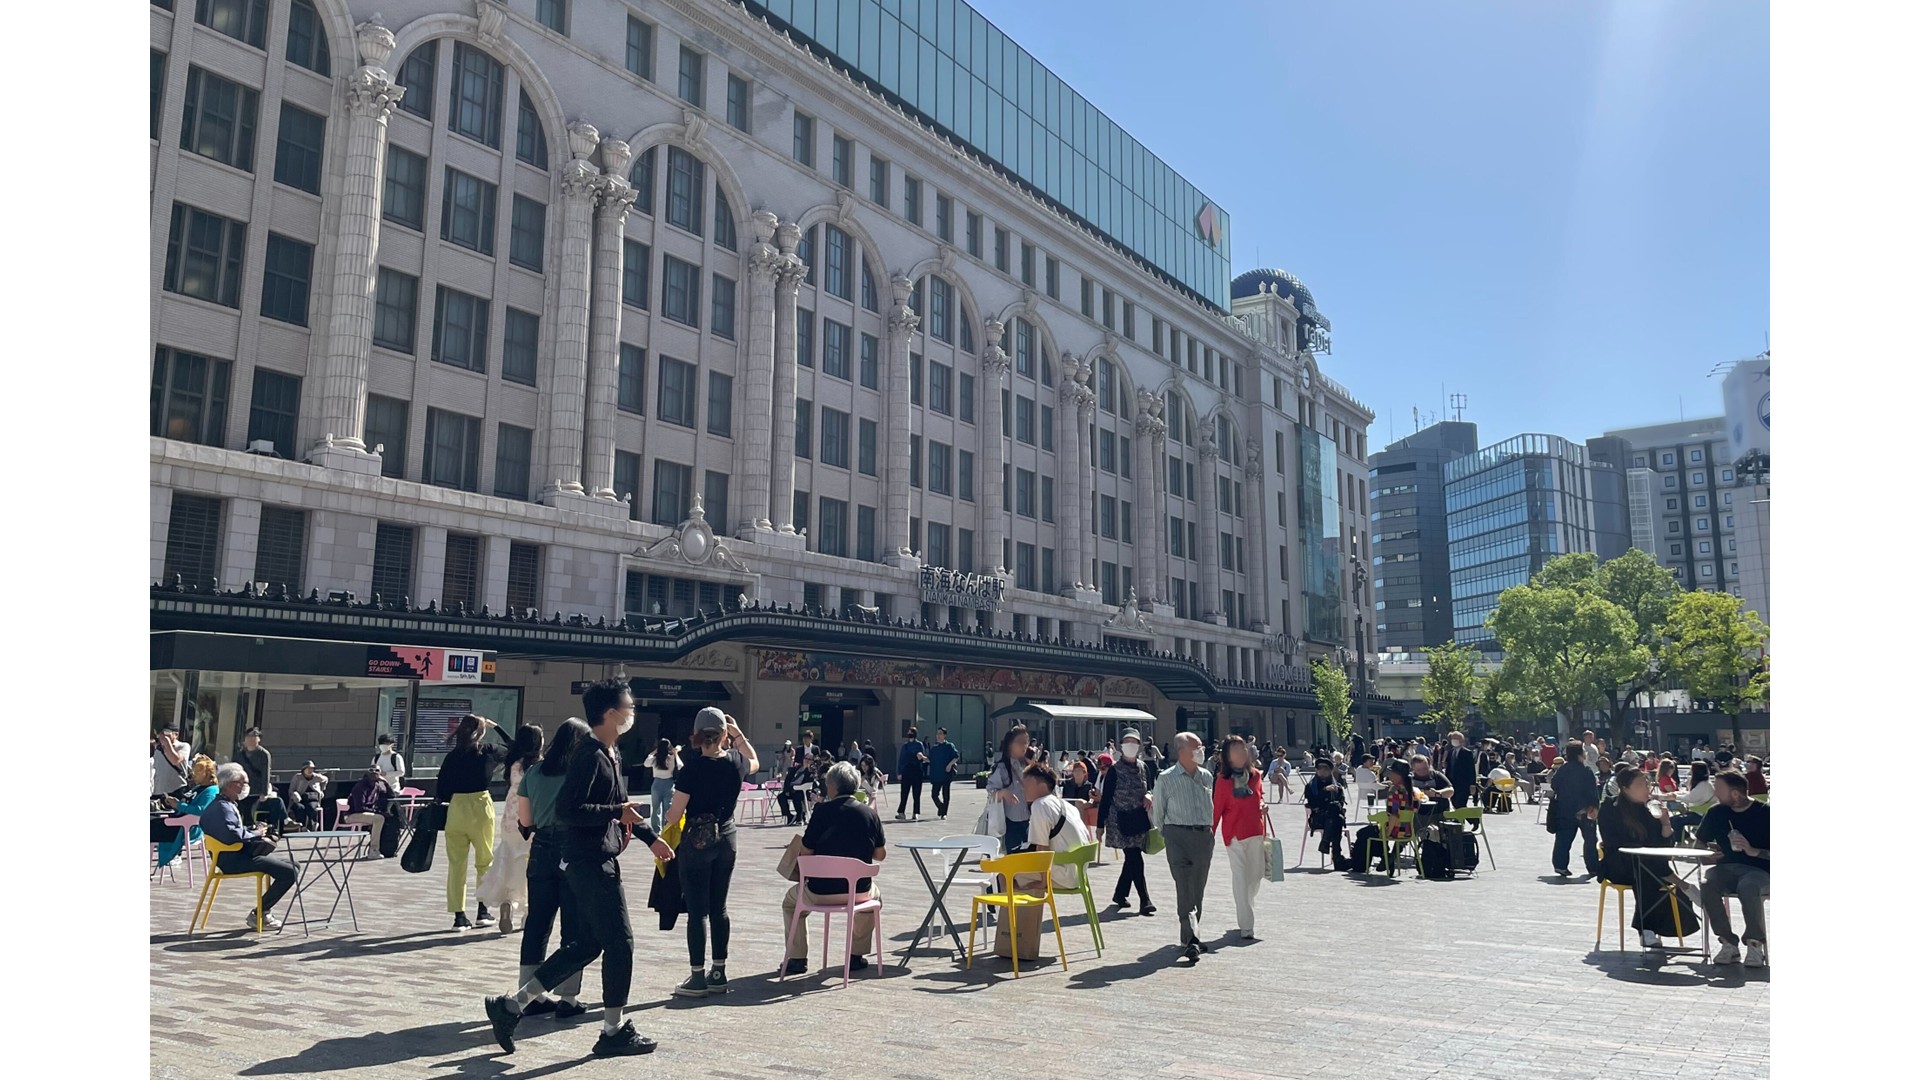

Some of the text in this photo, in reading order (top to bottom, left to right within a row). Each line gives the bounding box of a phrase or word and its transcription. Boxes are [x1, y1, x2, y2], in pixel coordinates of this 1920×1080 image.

[919, 564, 1005, 602] 南海なんば駅
[924, 589, 958, 606] NANKAI
[958, 595, 985, 611] NAMBA
[368, 665, 393, 673] STAIRS!
